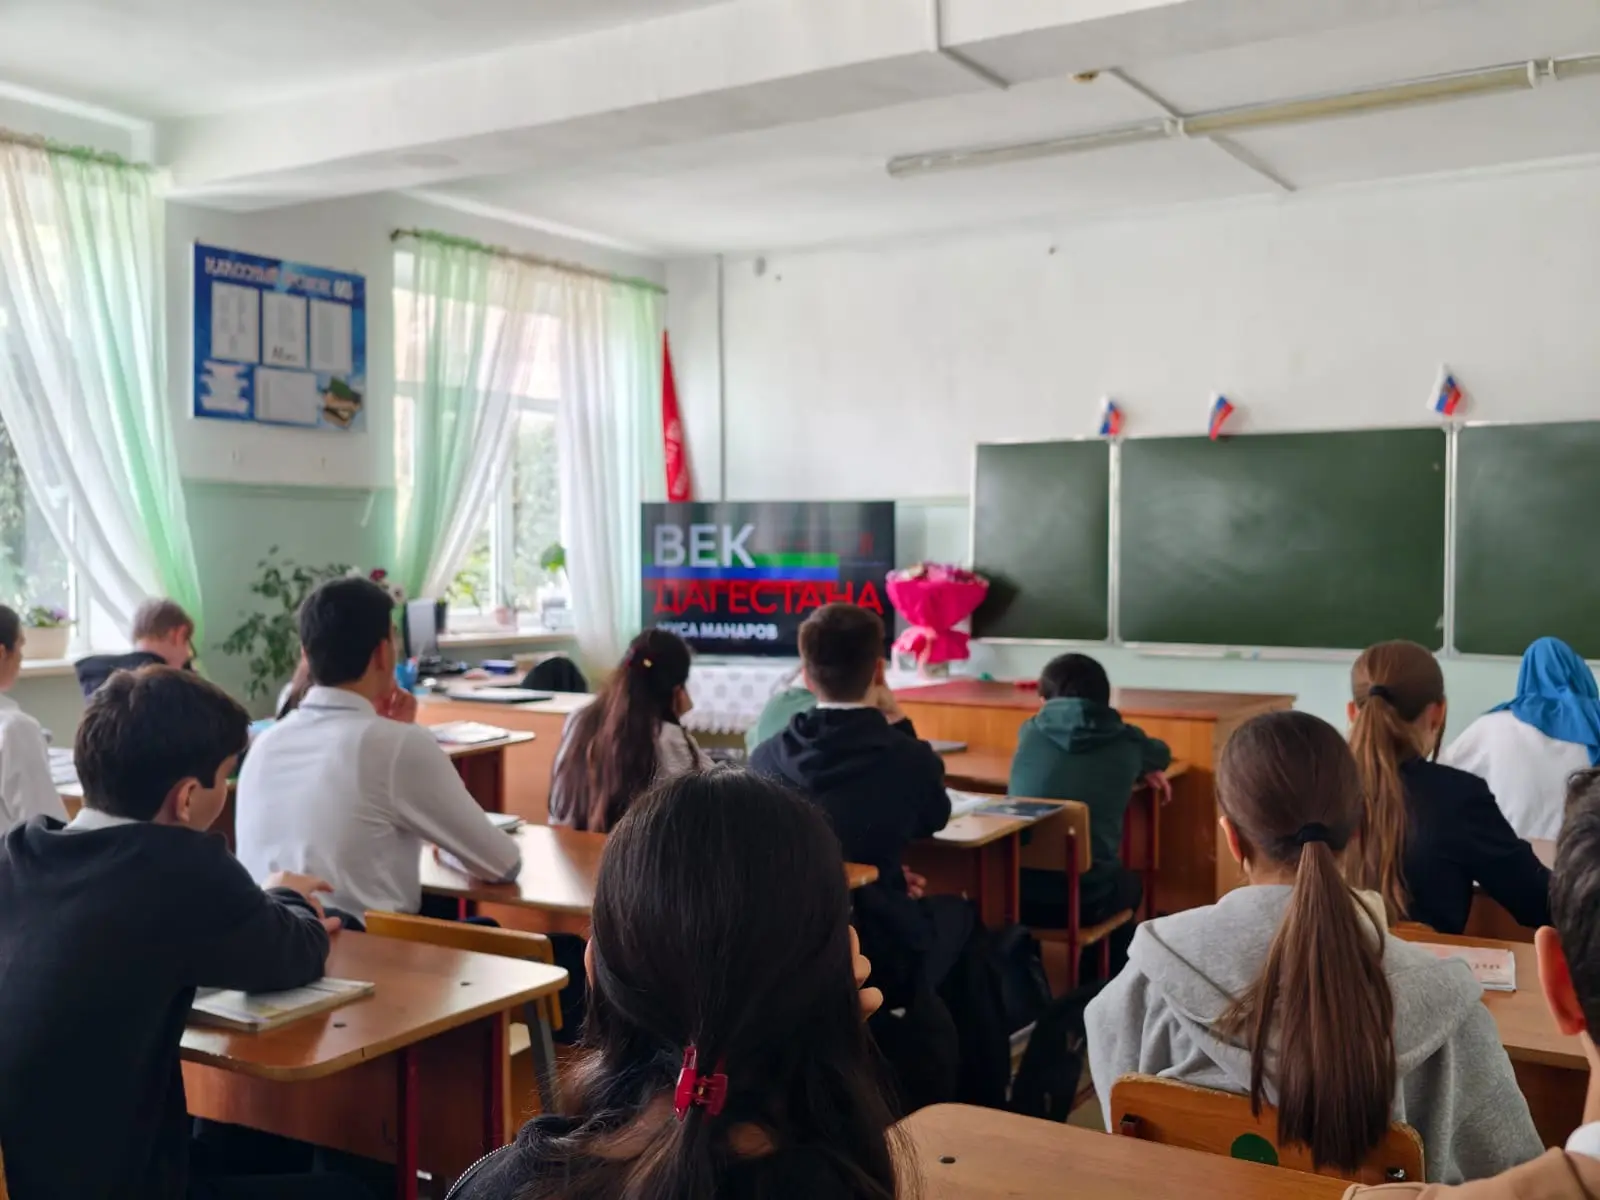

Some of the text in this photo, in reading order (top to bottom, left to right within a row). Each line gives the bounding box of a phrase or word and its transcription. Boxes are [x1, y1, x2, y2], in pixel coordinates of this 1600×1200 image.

[653, 523, 756, 568] ВЕК
[653, 580, 884, 616] ДАГЕСТАНА
[700, 622, 778, 641] МАНАРОВ
